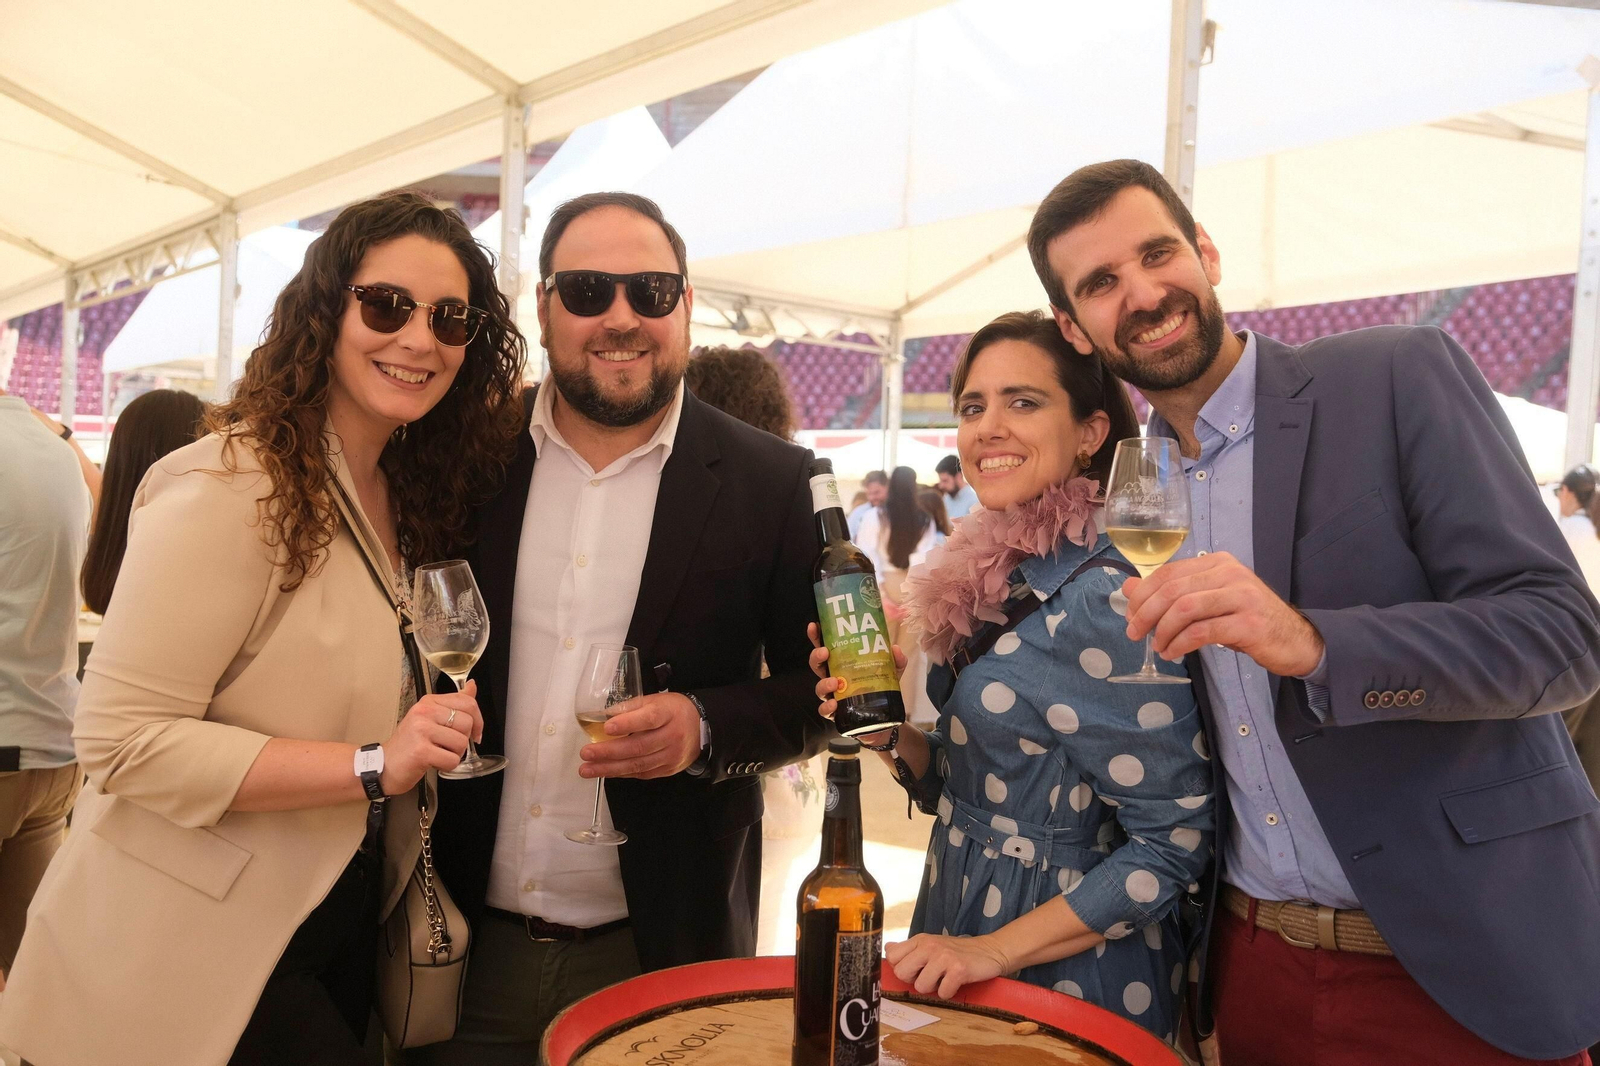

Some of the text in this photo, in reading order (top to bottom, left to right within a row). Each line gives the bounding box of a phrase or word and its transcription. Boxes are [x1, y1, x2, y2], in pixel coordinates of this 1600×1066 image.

[826, 593, 855, 616] TI
[836, 612, 880, 637] NA
[832, 639, 849, 648] Vino
[858, 633, 889, 655] JA
